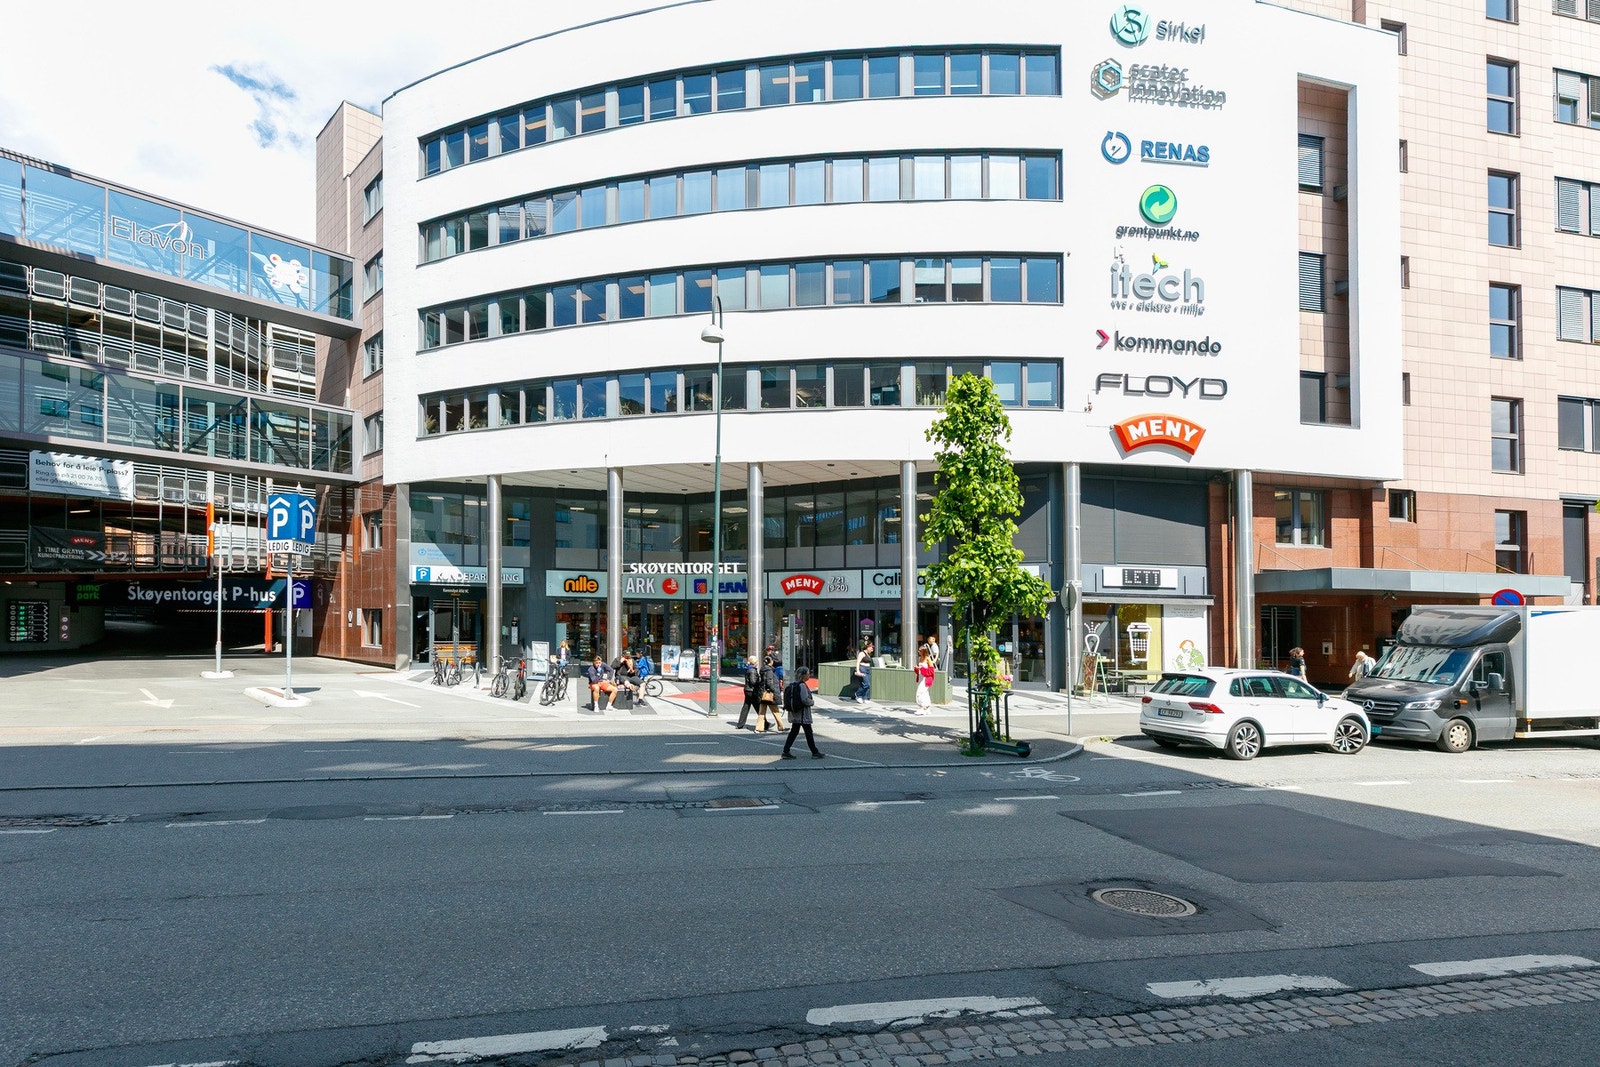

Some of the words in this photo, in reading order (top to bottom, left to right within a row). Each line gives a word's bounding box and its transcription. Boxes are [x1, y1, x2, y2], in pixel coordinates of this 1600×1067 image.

[1156, 20, 1205, 43] Sirkel
[1129, 63, 1189, 82] scatec
[1129, 84, 1226, 107] innovation
[1140, 140, 1210, 163] RENAS
[111, 215, 205, 259] Elavon
[1115, 225, 1200, 241] grøntpunkt.no
[1110, 262, 1205, 303] itech
[1114, 330, 1222, 355] kommando
[1095, 373, 1228, 398] FLOYD
[1127, 419, 1199, 442] MENY
[35, 459, 60, 467] Behov
[273, 508, 288, 537] P
[301, 509, 314, 538] P
[268, 542, 290, 551] LEDIG
[292, 542, 309, 554] LEDIG
[630, 562, 741, 574] SKØYENTORGET
[1124, 570, 1160, 584] LETT
[564, 574, 599, 593] nille
[626, 577, 656, 593] ARK
[785, 577, 820, 590] MENY
[76, 592, 100, 601] park
[127, 585, 228, 605] Skøyentorget
[232, 586, 277, 602] P-hus
[293, 588, 304, 605] P
